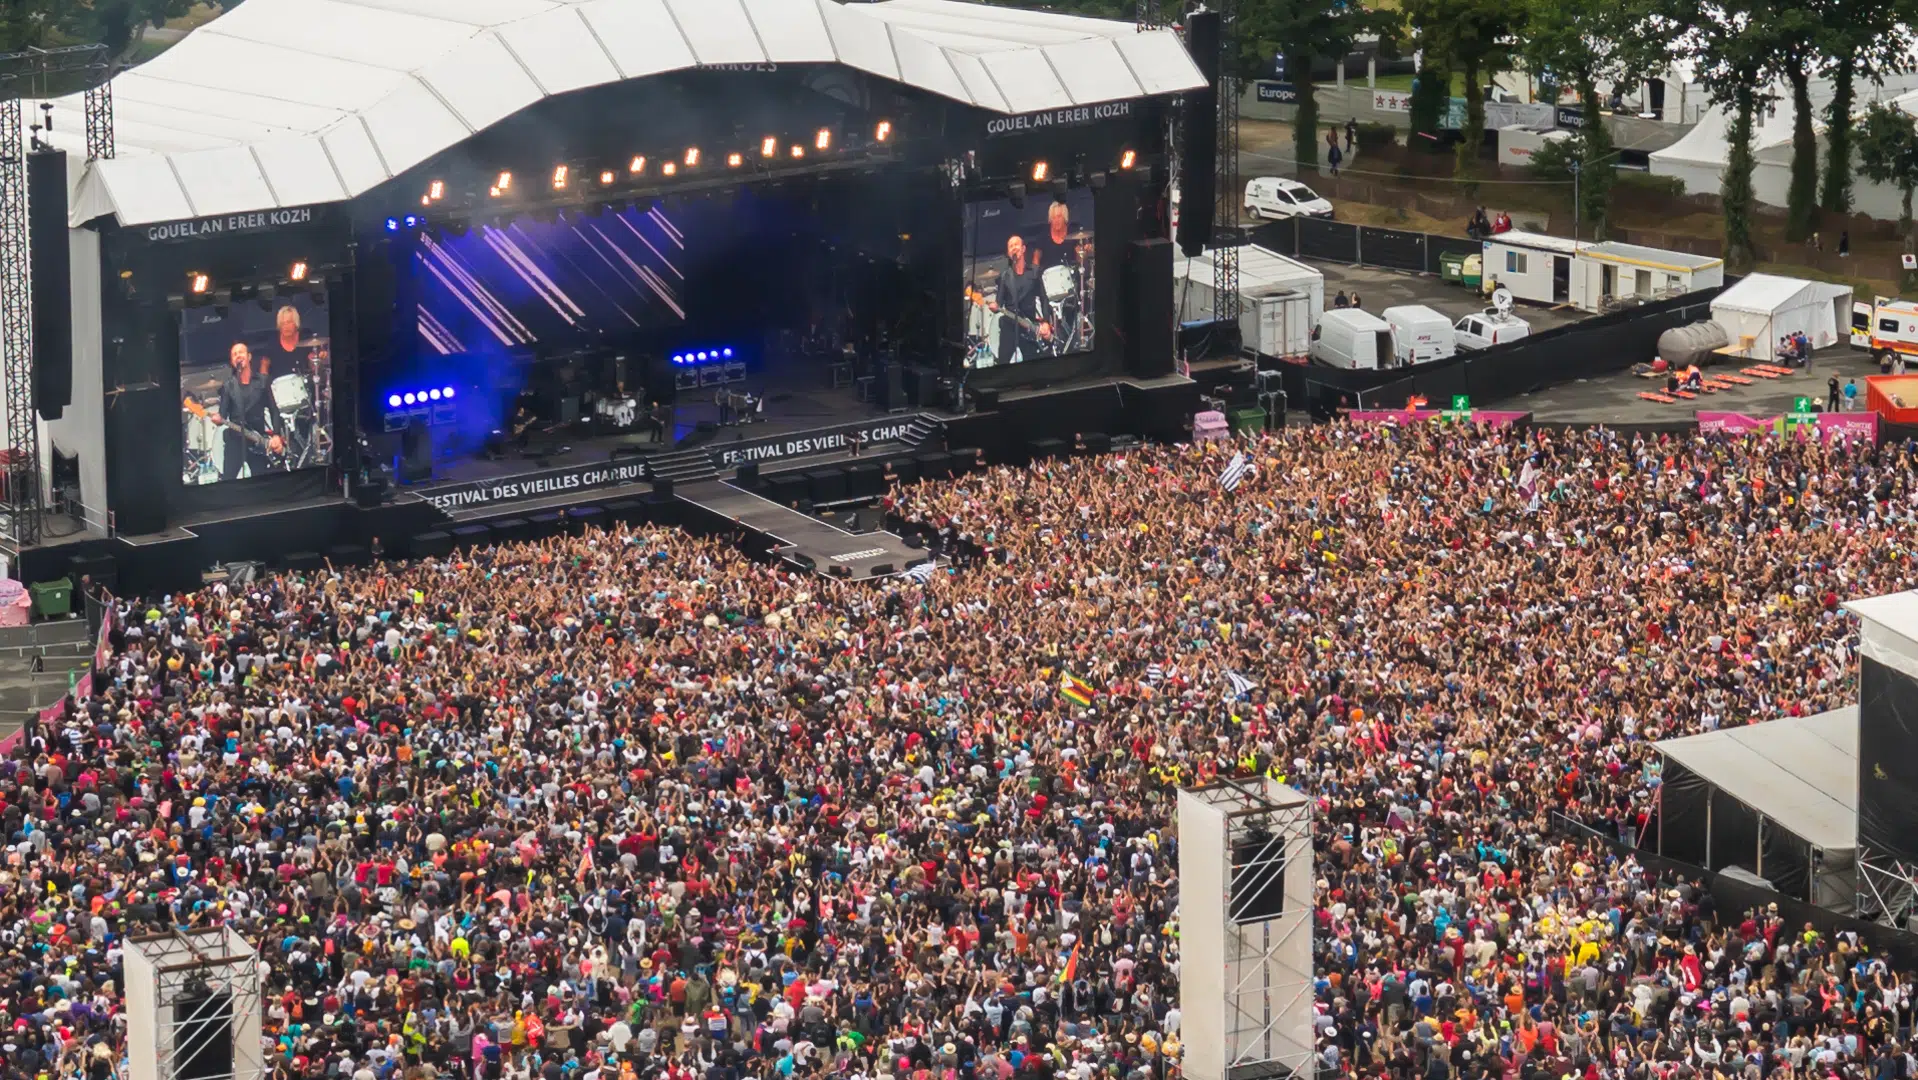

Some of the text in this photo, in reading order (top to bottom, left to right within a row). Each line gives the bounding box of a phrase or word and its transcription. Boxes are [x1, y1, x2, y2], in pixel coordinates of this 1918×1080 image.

[987, 102, 1129, 134] GOUEL AN ERER KOZH
[1559, 112, 1588, 127] Europ
[148, 208, 311, 241] GOUEL AN ERER KOZH
[723, 443, 783, 465] FESTIVAL
[786, 439, 811, 454] DES
[812, 430, 868, 450] VIEILS
[493, 484, 518, 499] DES
[520, 474, 579, 495] VIEILLES
